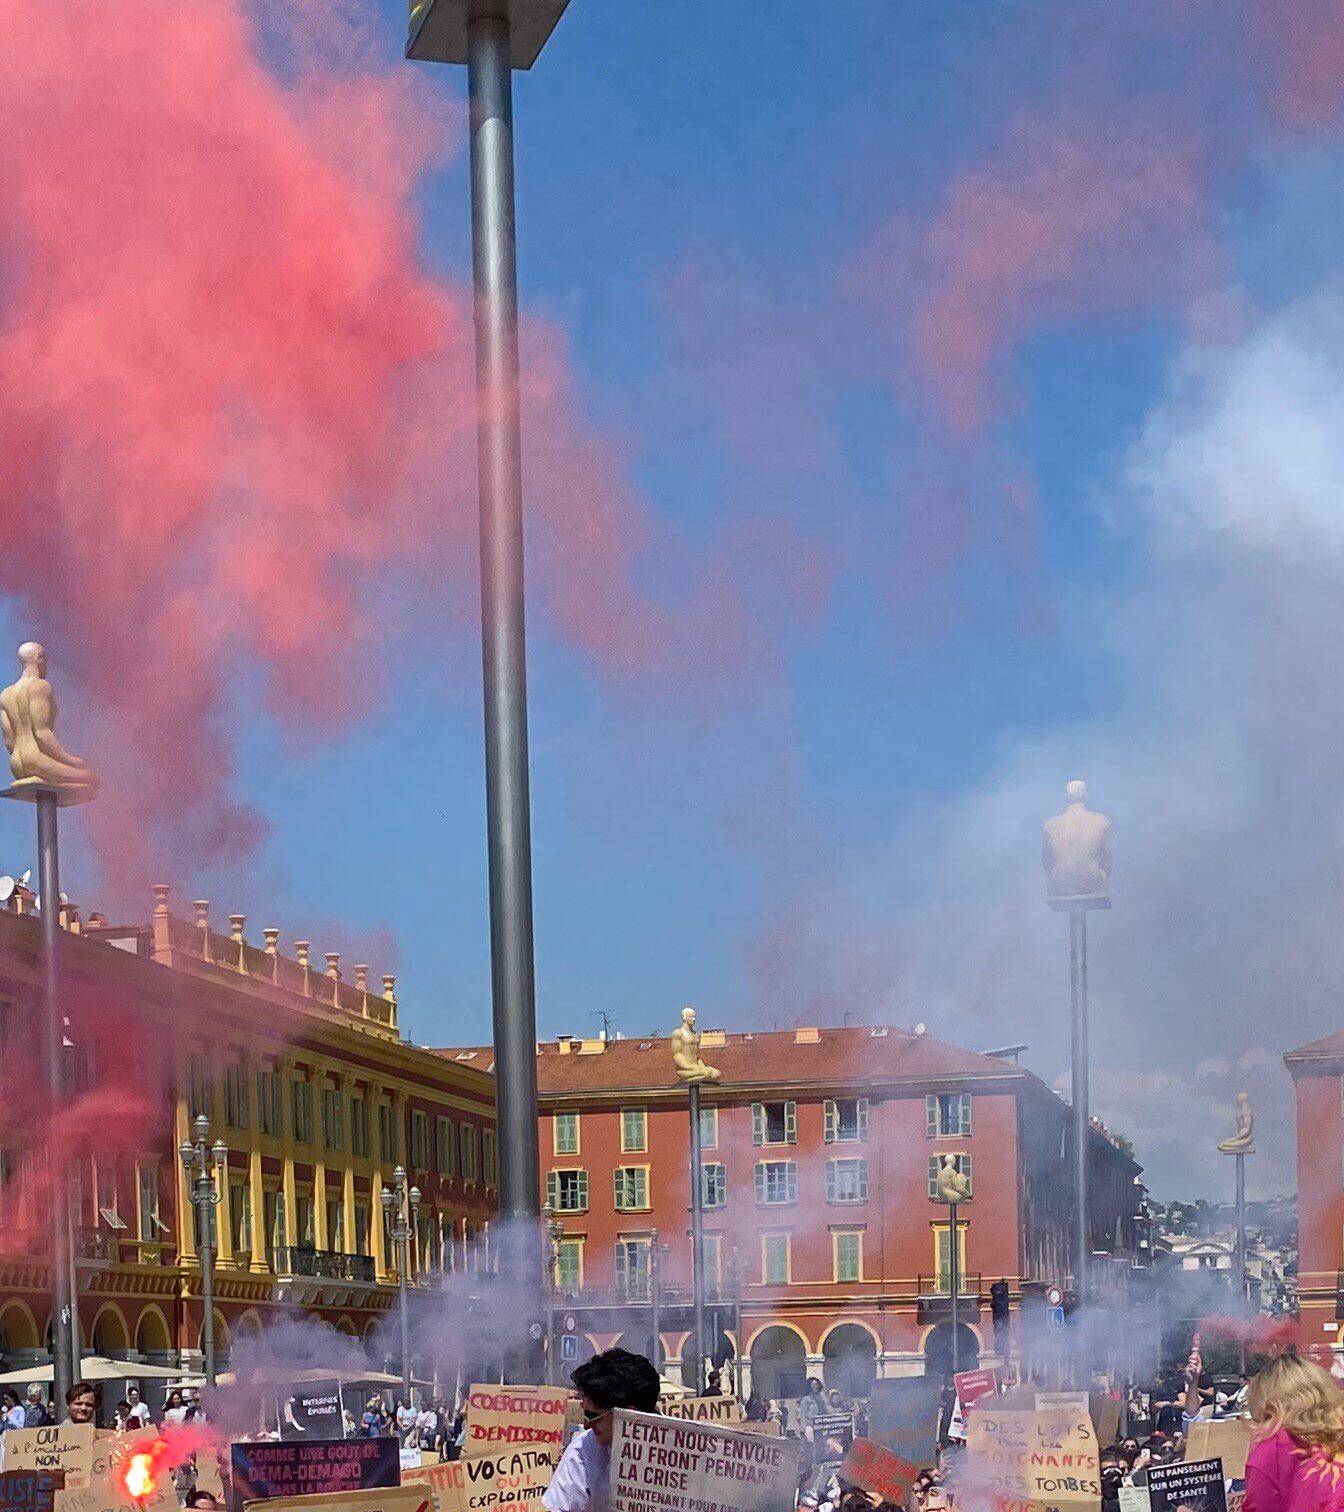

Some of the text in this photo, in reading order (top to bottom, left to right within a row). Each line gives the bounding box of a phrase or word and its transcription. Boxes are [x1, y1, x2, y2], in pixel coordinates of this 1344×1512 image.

[36, 1428, 60, 1445] OUI
[673, 1428, 718, 1454] NOUS
[722, 1437, 780, 1467] ENVOIE
[35, 1455, 60, 1467] NON
[620, 1442, 701, 1472] AU FRONT
[618, 1462, 689, 1491] LA CRISE
[616, 1484, 687, 1509] MAINTENANT
